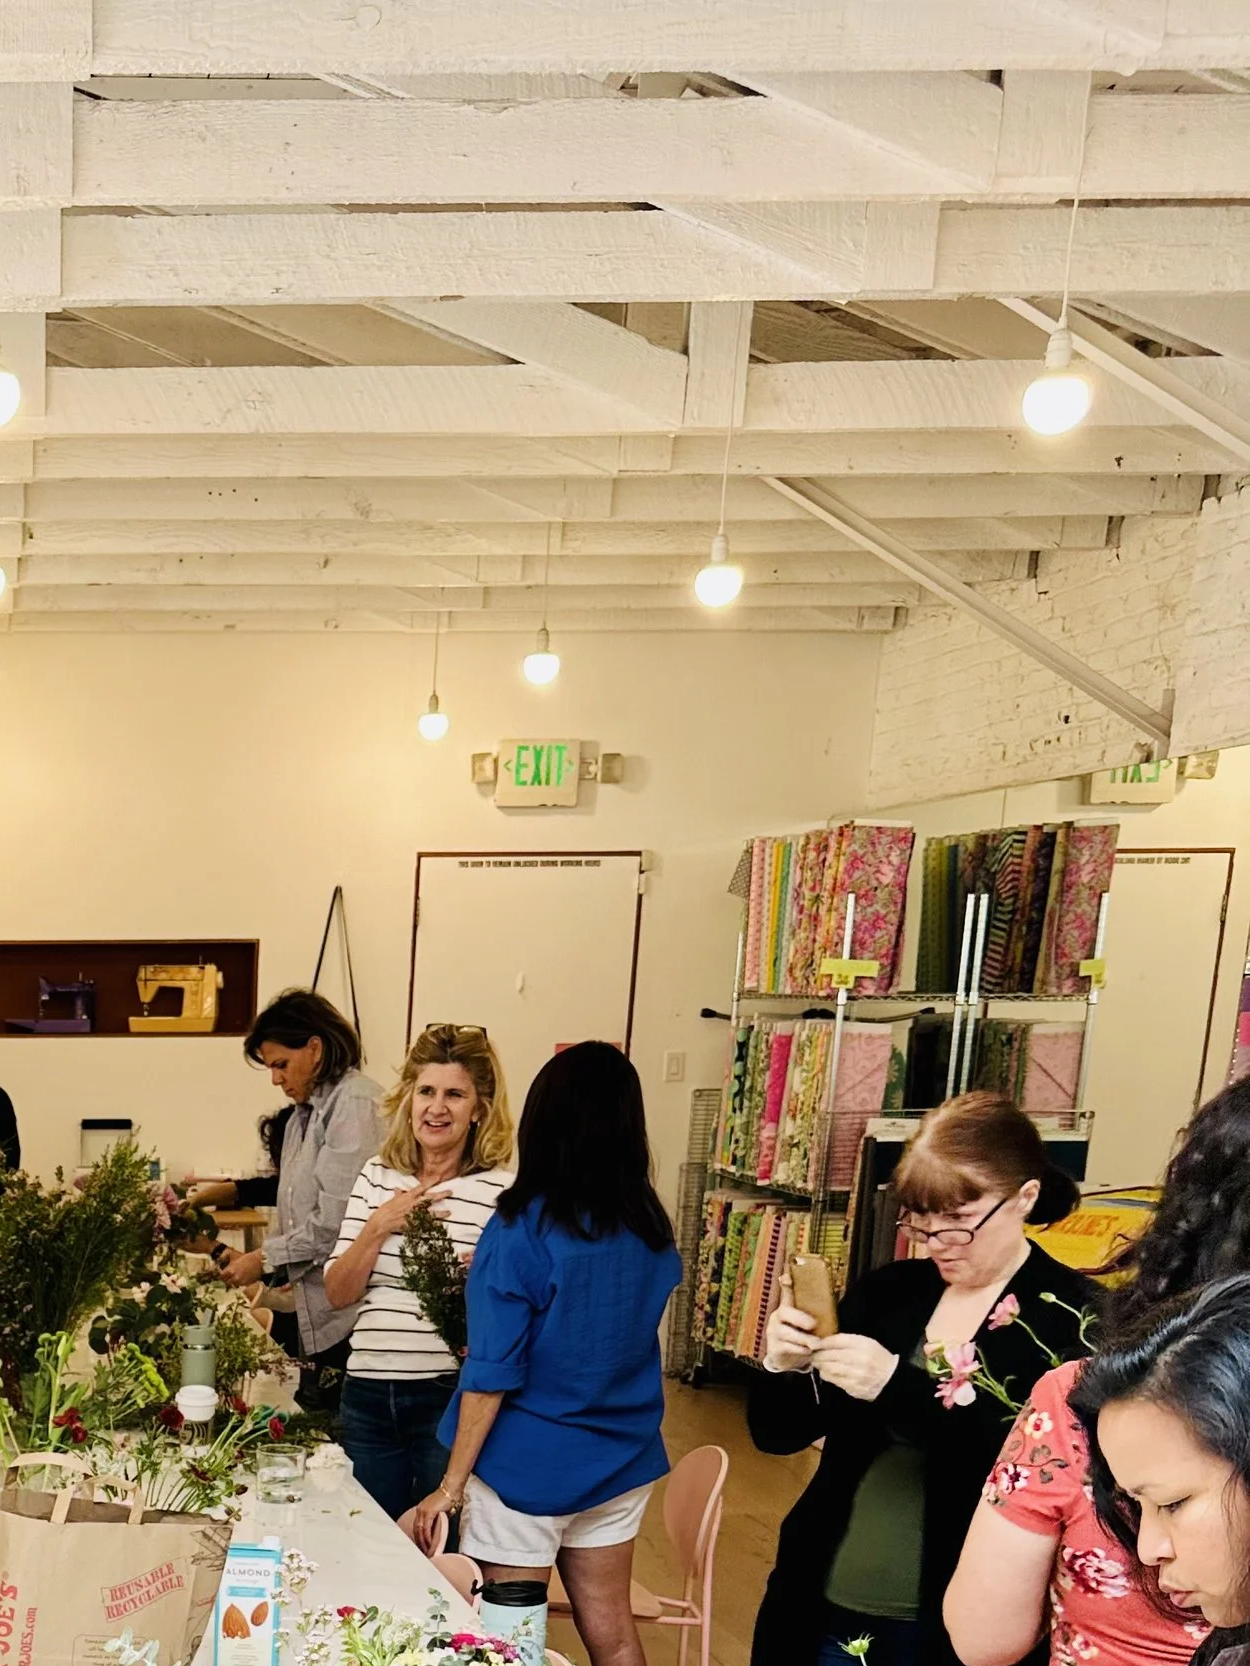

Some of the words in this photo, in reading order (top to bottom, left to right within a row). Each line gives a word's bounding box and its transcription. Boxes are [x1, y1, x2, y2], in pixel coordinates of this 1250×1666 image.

[514, 745, 567, 787] EXIT
[110, 1562, 175, 1602] REUSABLE
[226, 1568, 271, 1578] ALMOND
[106, 1575, 184, 1619] RECYCLABLE
